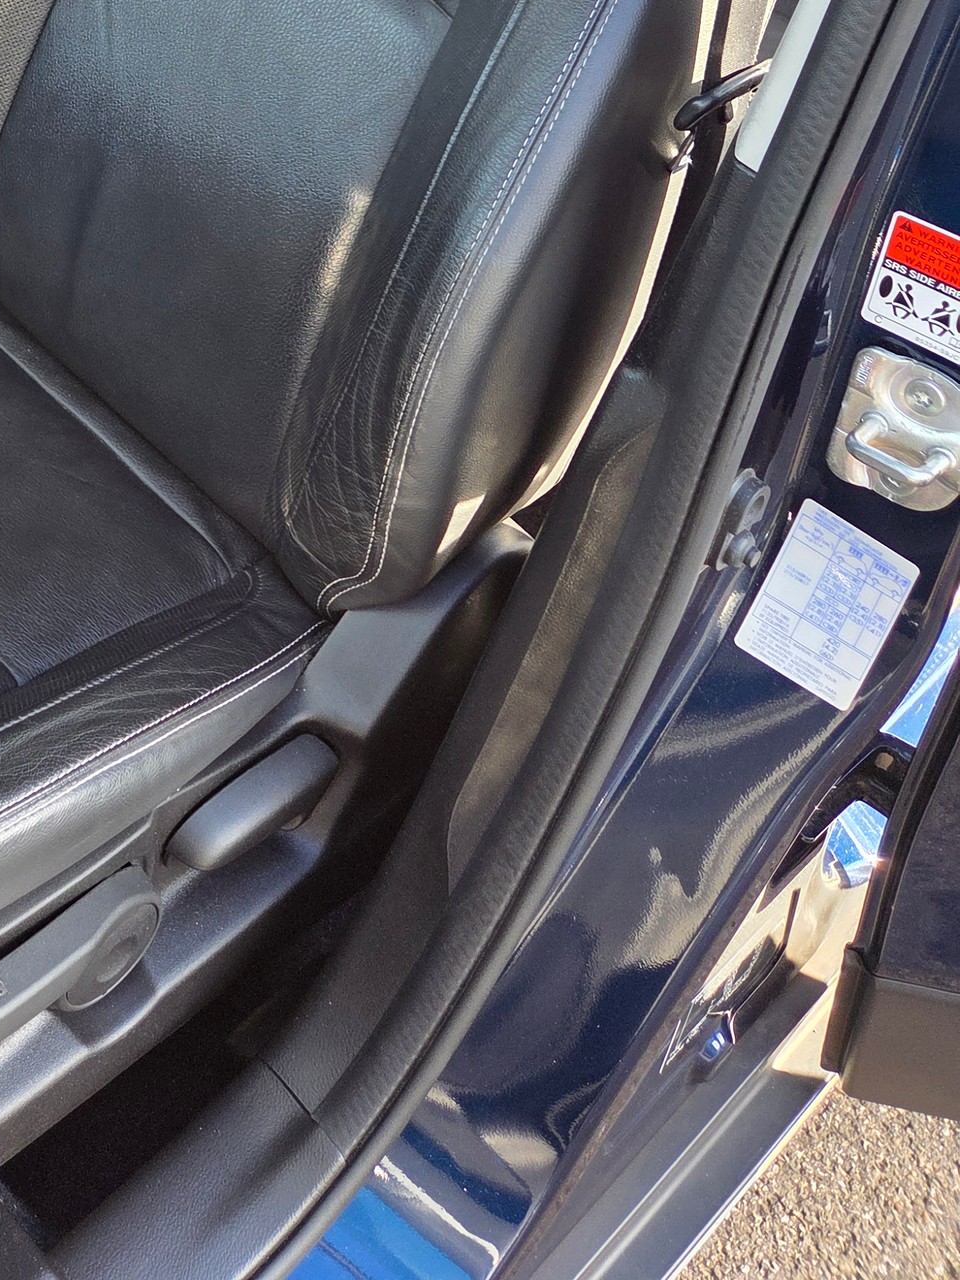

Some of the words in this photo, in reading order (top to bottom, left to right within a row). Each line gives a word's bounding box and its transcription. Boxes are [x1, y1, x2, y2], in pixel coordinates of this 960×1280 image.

[896, 231, 960, 264] AVERTISSE
[884, 259, 908, 274] SRS
[908, 269, 936, 287] SIDE
[905, 256, 960, 285] WARNUN
